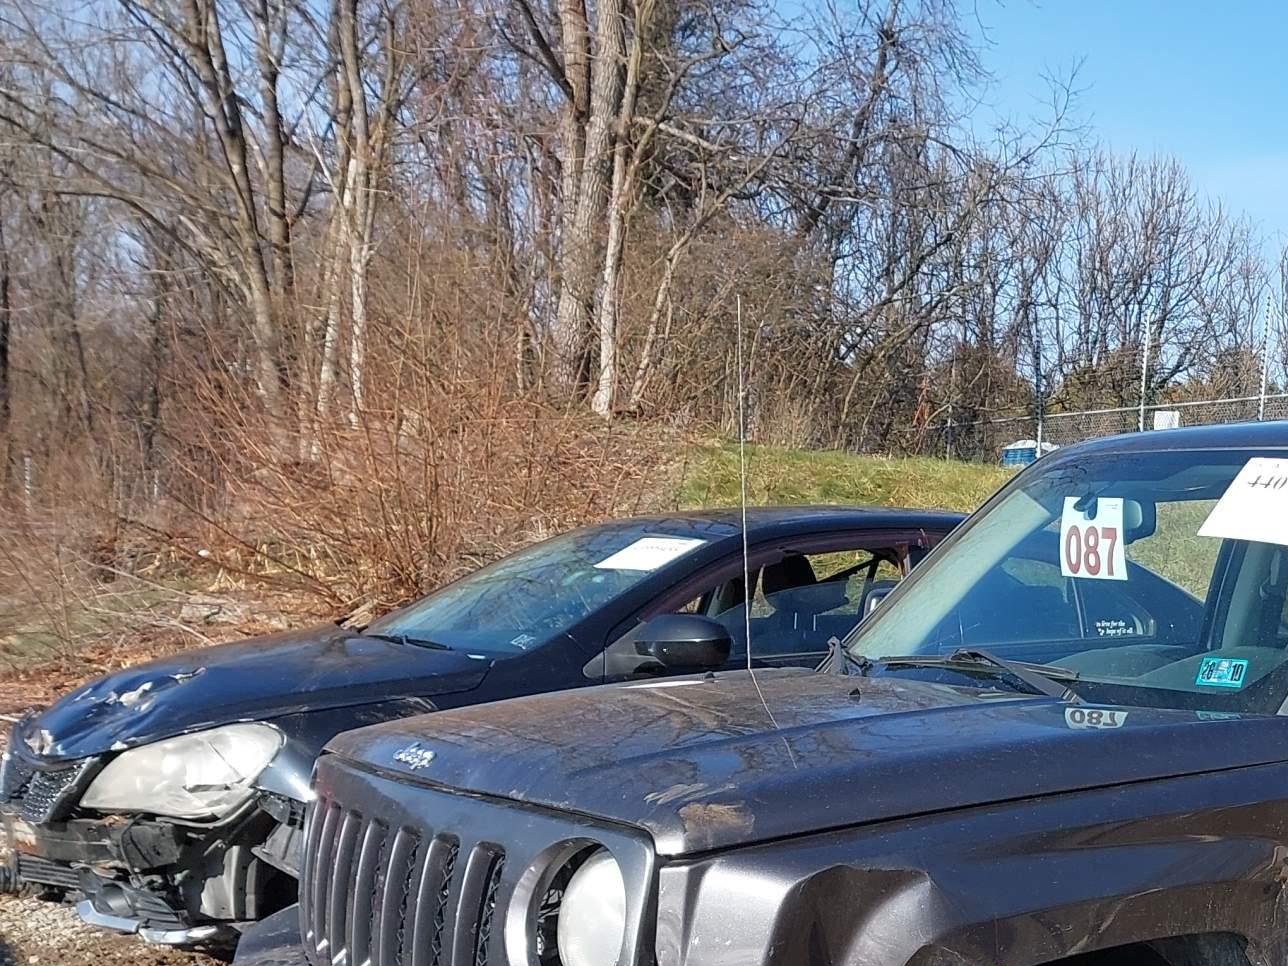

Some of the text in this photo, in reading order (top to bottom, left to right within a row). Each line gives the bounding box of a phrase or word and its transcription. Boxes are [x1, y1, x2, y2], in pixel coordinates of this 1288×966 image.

[1065, 524, 1118, 577] 087
[1230, 663, 1244, 682] 10
[393, 741, 437, 770] Jeep
